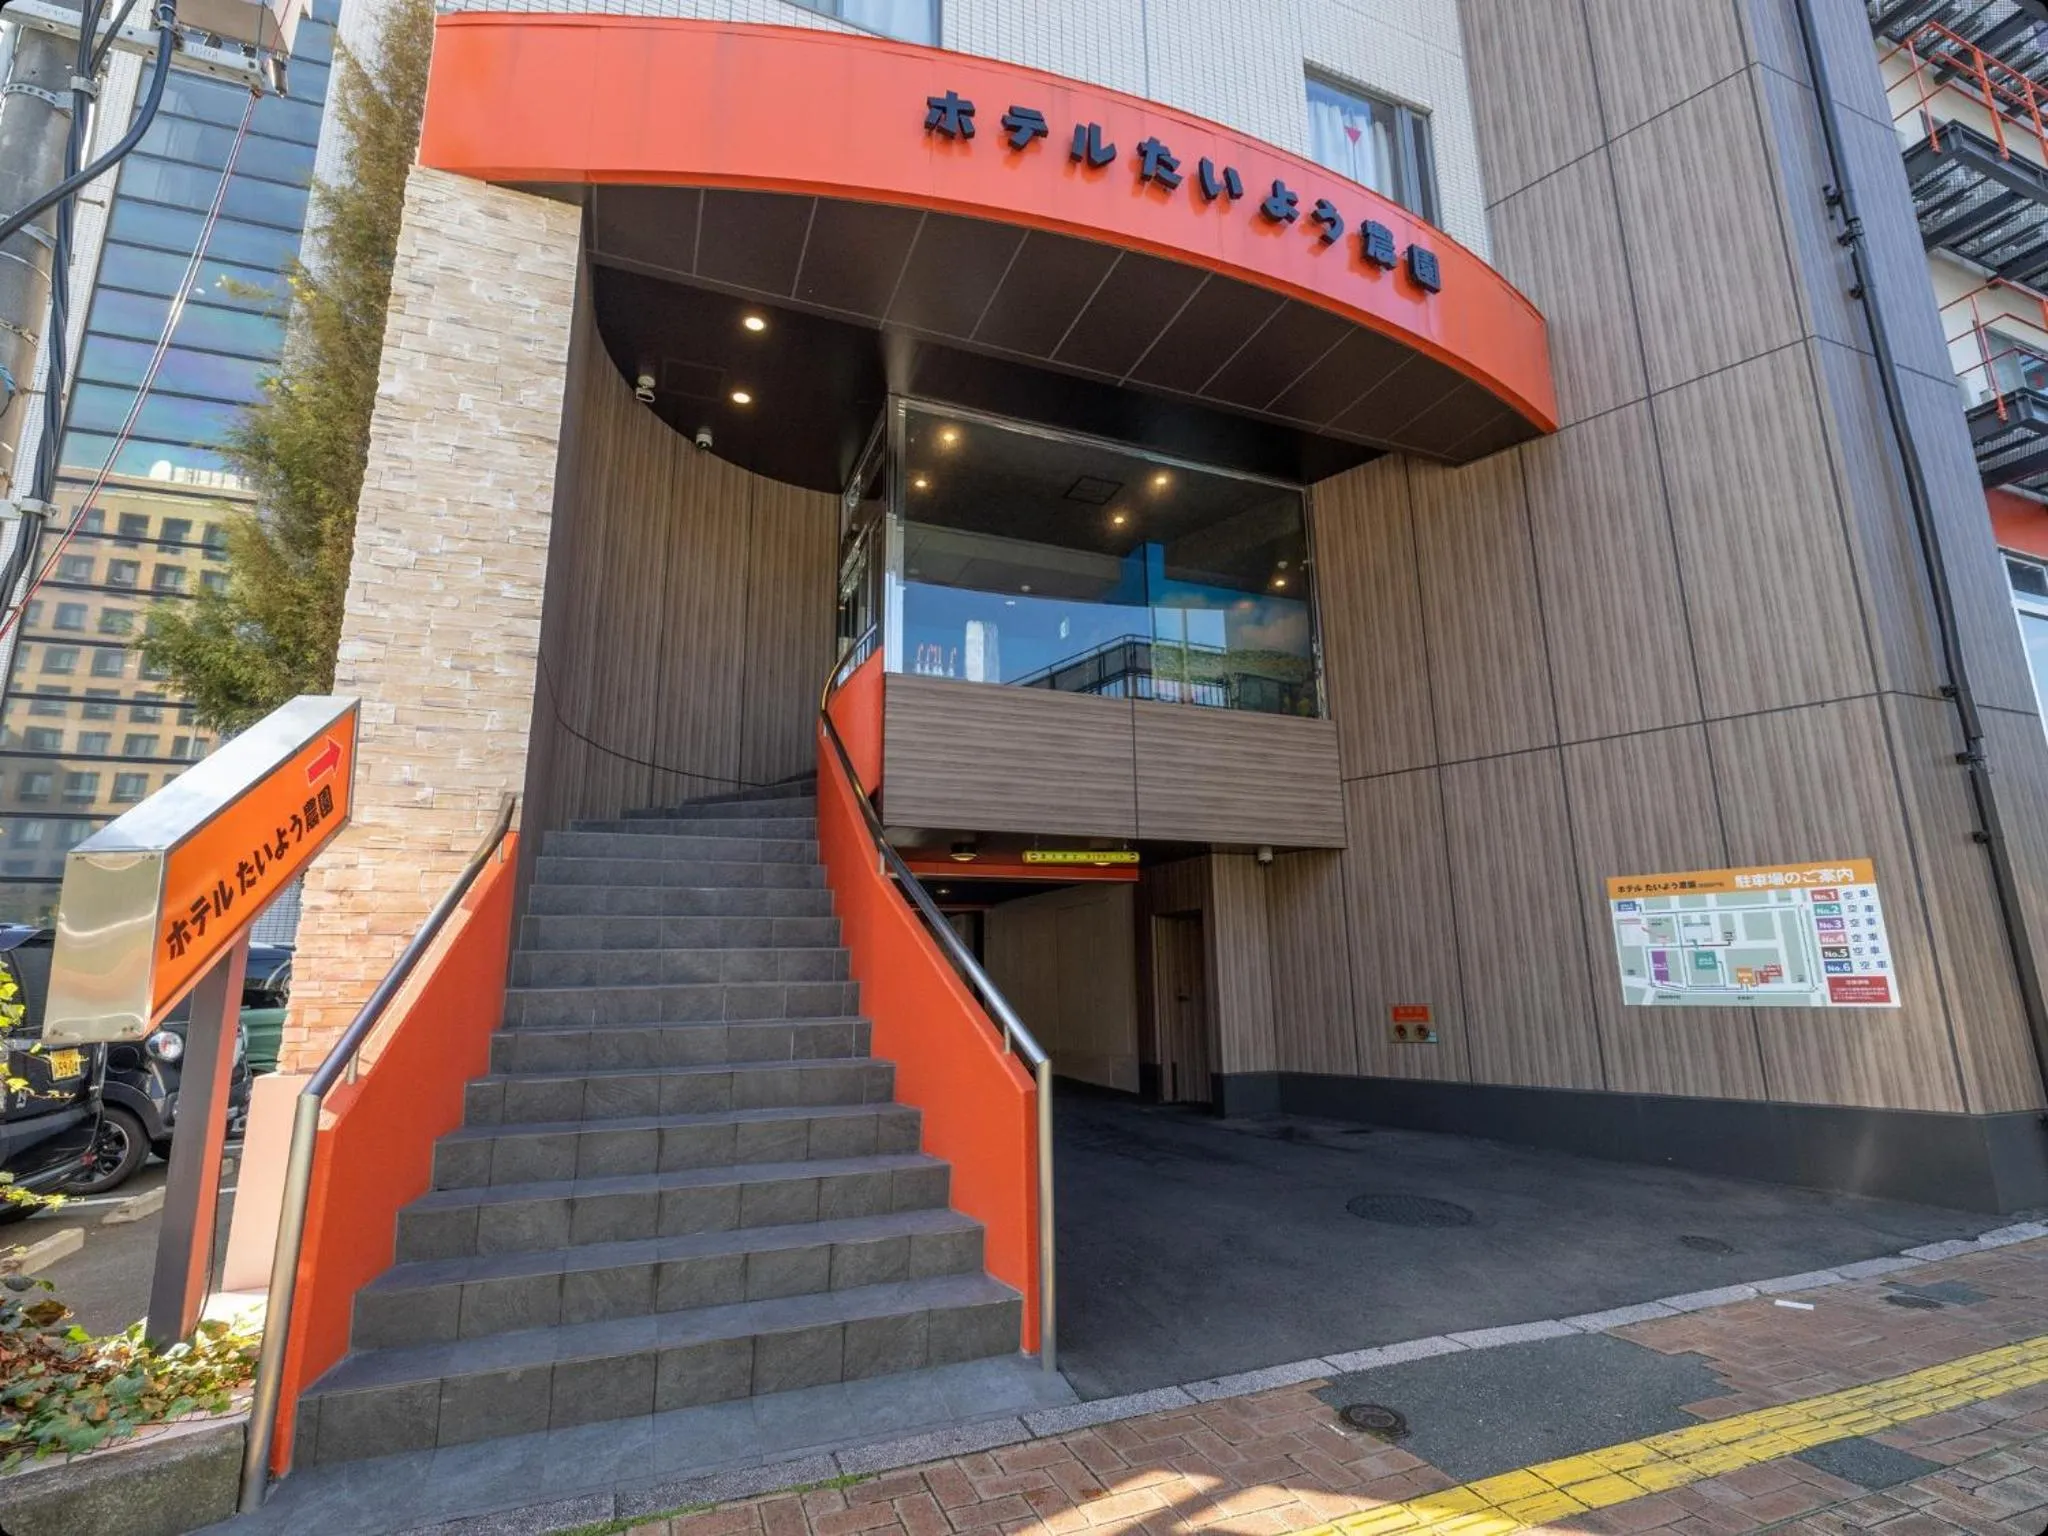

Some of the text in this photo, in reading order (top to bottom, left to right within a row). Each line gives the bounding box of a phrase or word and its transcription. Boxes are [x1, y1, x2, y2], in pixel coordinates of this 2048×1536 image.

[1735, 868, 1855, 888] 駐車場のご案内
[1813, 890, 1836, 902] No.1
[1817, 905, 1840, 915] No.2
[1819, 919, 1843, 929] No.3
[1822, 933, 1845, 943] No.4
[1824, 948, 1848, 958] No.5
[1828, 963, 1851, 972] No.6
